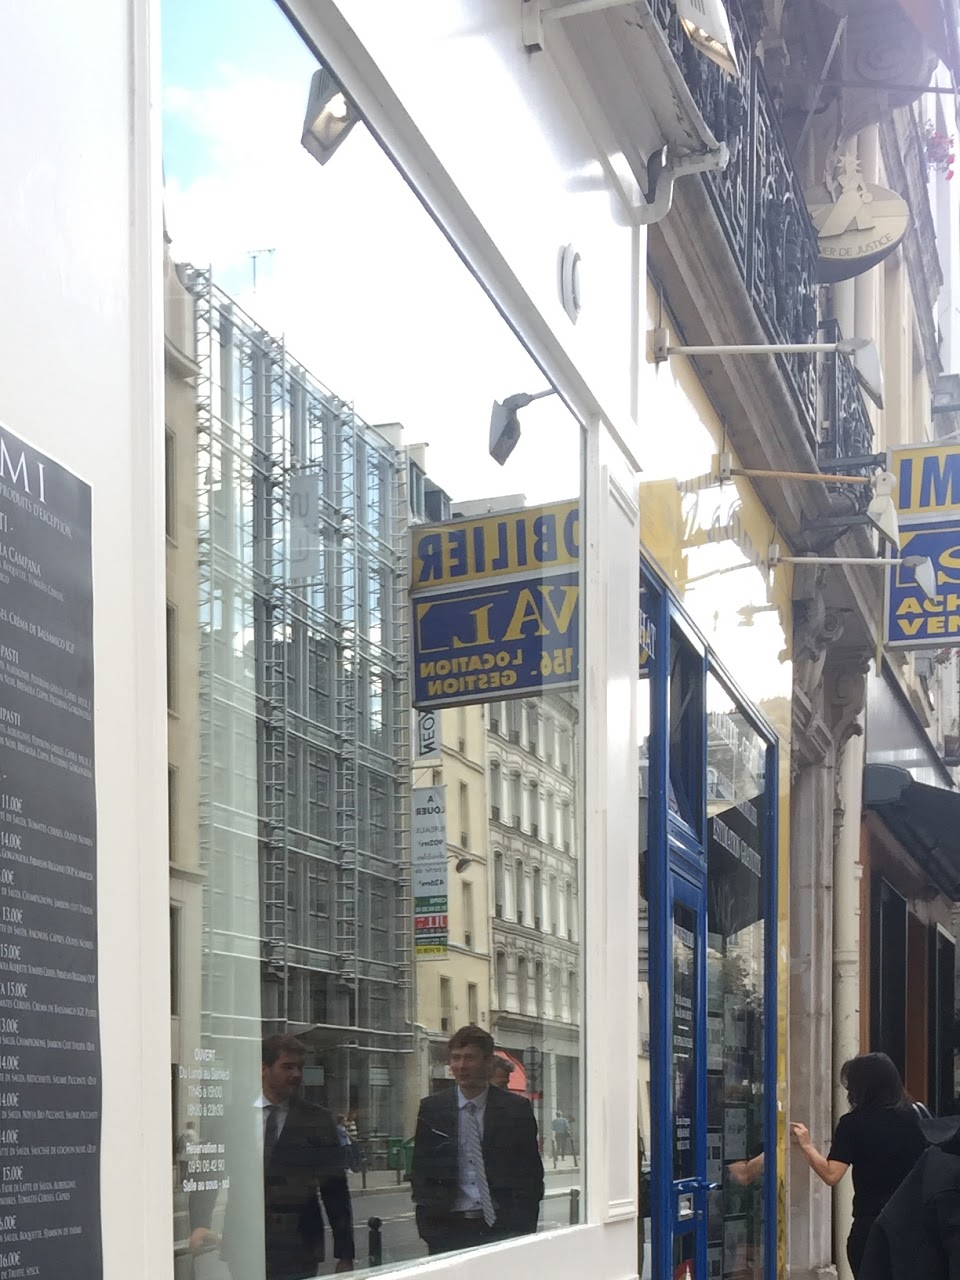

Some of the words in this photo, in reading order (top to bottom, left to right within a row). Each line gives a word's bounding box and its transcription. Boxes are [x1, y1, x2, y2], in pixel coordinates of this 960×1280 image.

[838, 247, 852, 256] DE
[856, 232, 893, 255] JUSTICE
[182, 1178, 197, 1192] Salle
